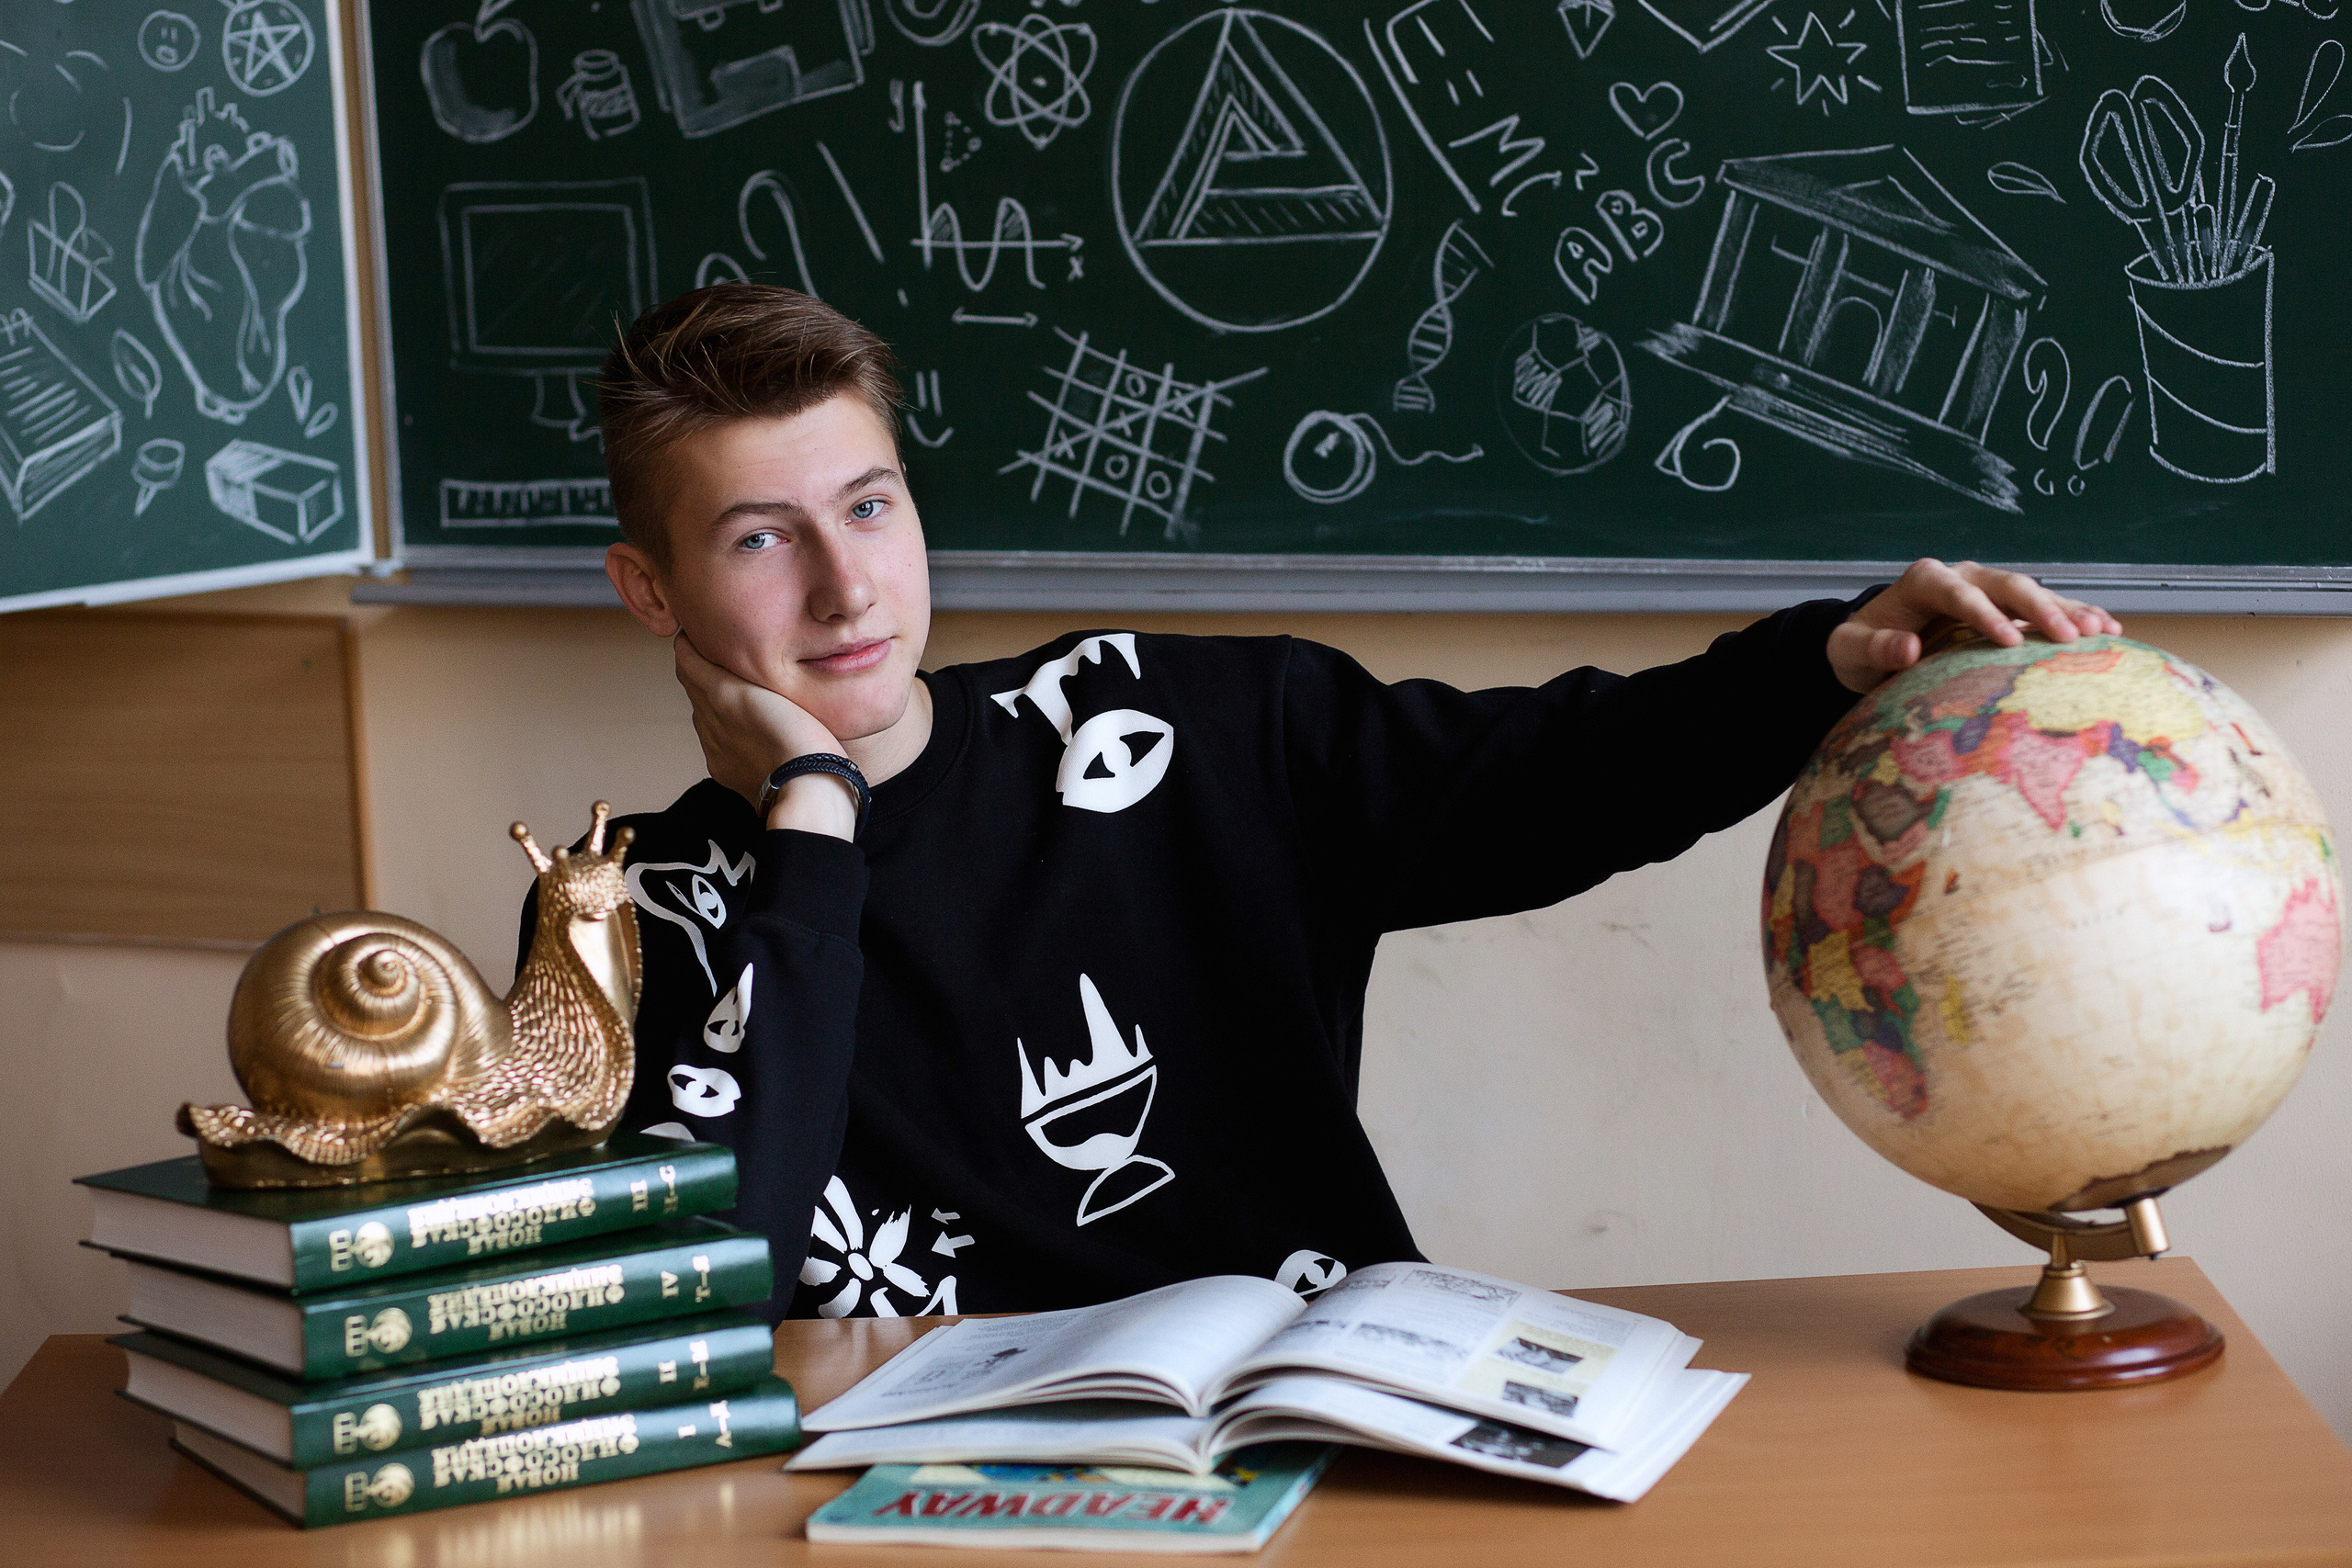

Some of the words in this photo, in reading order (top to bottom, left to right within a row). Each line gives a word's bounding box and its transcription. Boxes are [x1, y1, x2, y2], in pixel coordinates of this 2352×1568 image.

[410, 1196, 596, 1248] ФИЛОСОФСКАЯ
[468, 1224, 543, 1255] НОВАЯ
[429, 1284, 625, 1334] ФИЛОСОФСКАЯ
[489, 1310, 568, 1341] НОВАЯ
[419, 1377, 621, 1430] ФИЛОСОФСКАЯ
[481, 1405, 561, 1435] НОВАЯ
[433, 1434, 639, 1488] ФИЛОСОФСКАЯ
[496, 1461, 580, 1494] НОВАЯ
[873, 1489, 1233, 1525] HEADWAY
